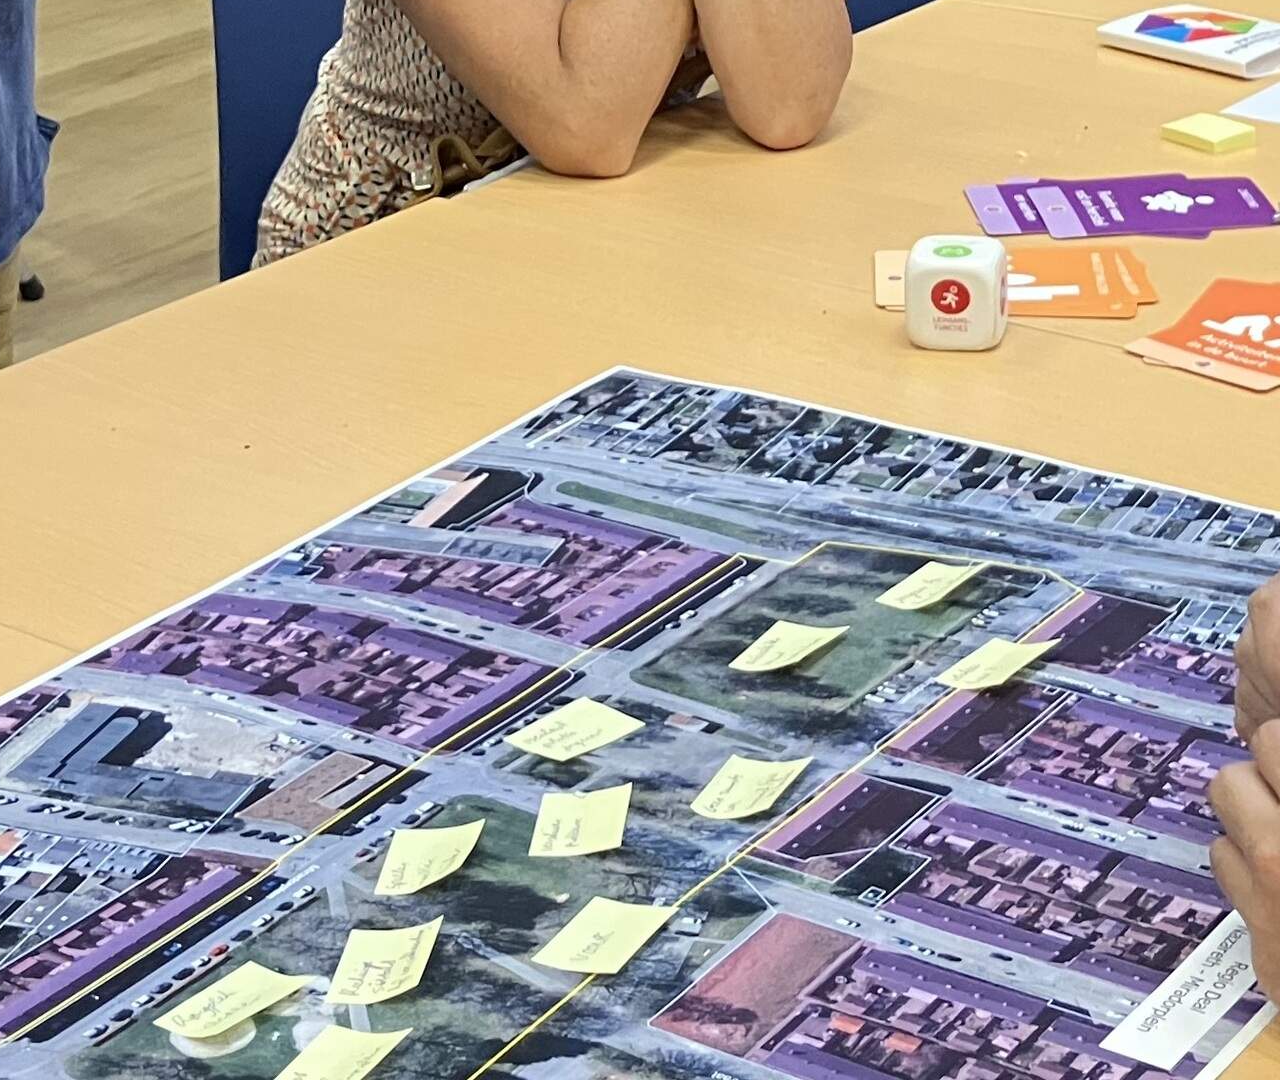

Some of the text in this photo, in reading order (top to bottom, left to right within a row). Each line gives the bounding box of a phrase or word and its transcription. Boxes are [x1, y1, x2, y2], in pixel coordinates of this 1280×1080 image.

[1136, 975, 1205, 1033] Miradorplein
[1190, 961, 1250, 1015] Regio Deal
